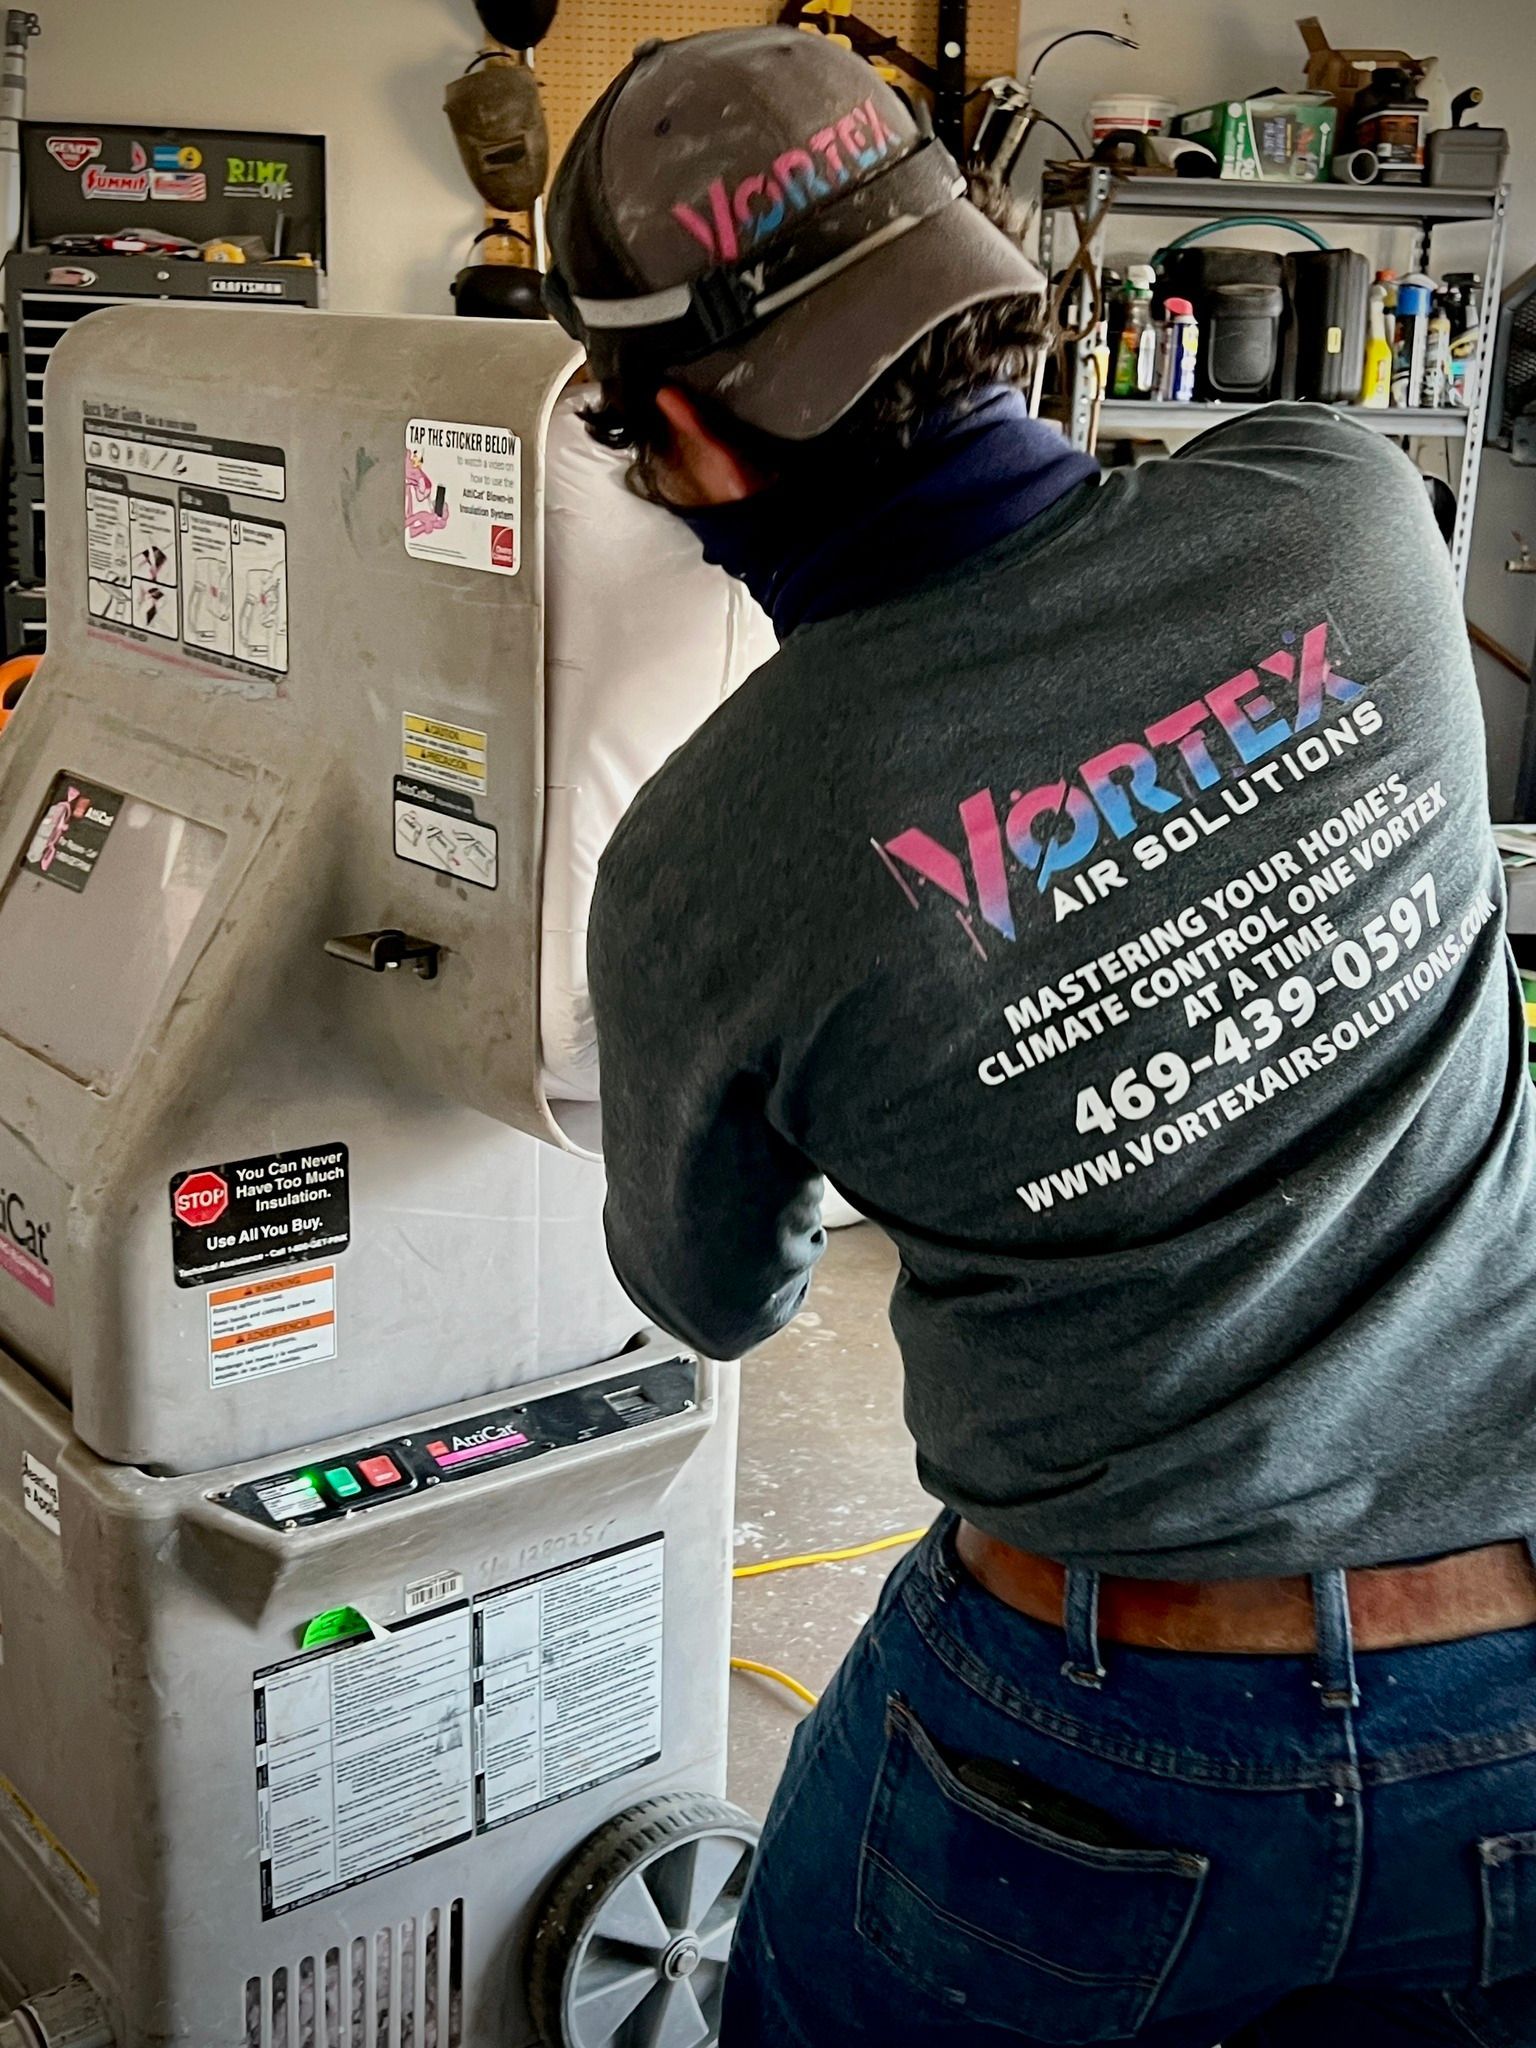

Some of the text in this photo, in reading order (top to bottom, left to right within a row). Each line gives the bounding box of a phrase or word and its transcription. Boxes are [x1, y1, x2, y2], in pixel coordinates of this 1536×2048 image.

[86, 170, 146, 191] SUMMIT
[672, 94, 902, 263] VORTEX
[410, 425, 516, 456] TAP THE STICKER BELOW
[884, 620, 1368, 942] VORTEX
[1053, 701, 1384, 922] AIR SOLUTIONS
[1003, 773, 1408, 1034] MASTERING YOUR HOME'S
[978, 780, 1448, 1086] CLIMATE CONTROL ONE VORTEX
[1183, 913, 1339, 1028] AT A TIME
[1075, 872, 1441, 1134] 469-439-0597
[236, 1152, 343, 1182] You Can Never
[236, 1166, 345, 1199] Have Too Much
[178, 1188, 225, 1212] STOP
[256, 1188, 332, 1212] Insulation.
[206, 1216, 324, 1250] Use All You Buy.
[178, 1262, 219, 1278] Technical
[270, 1247, 287, 1258] Call
